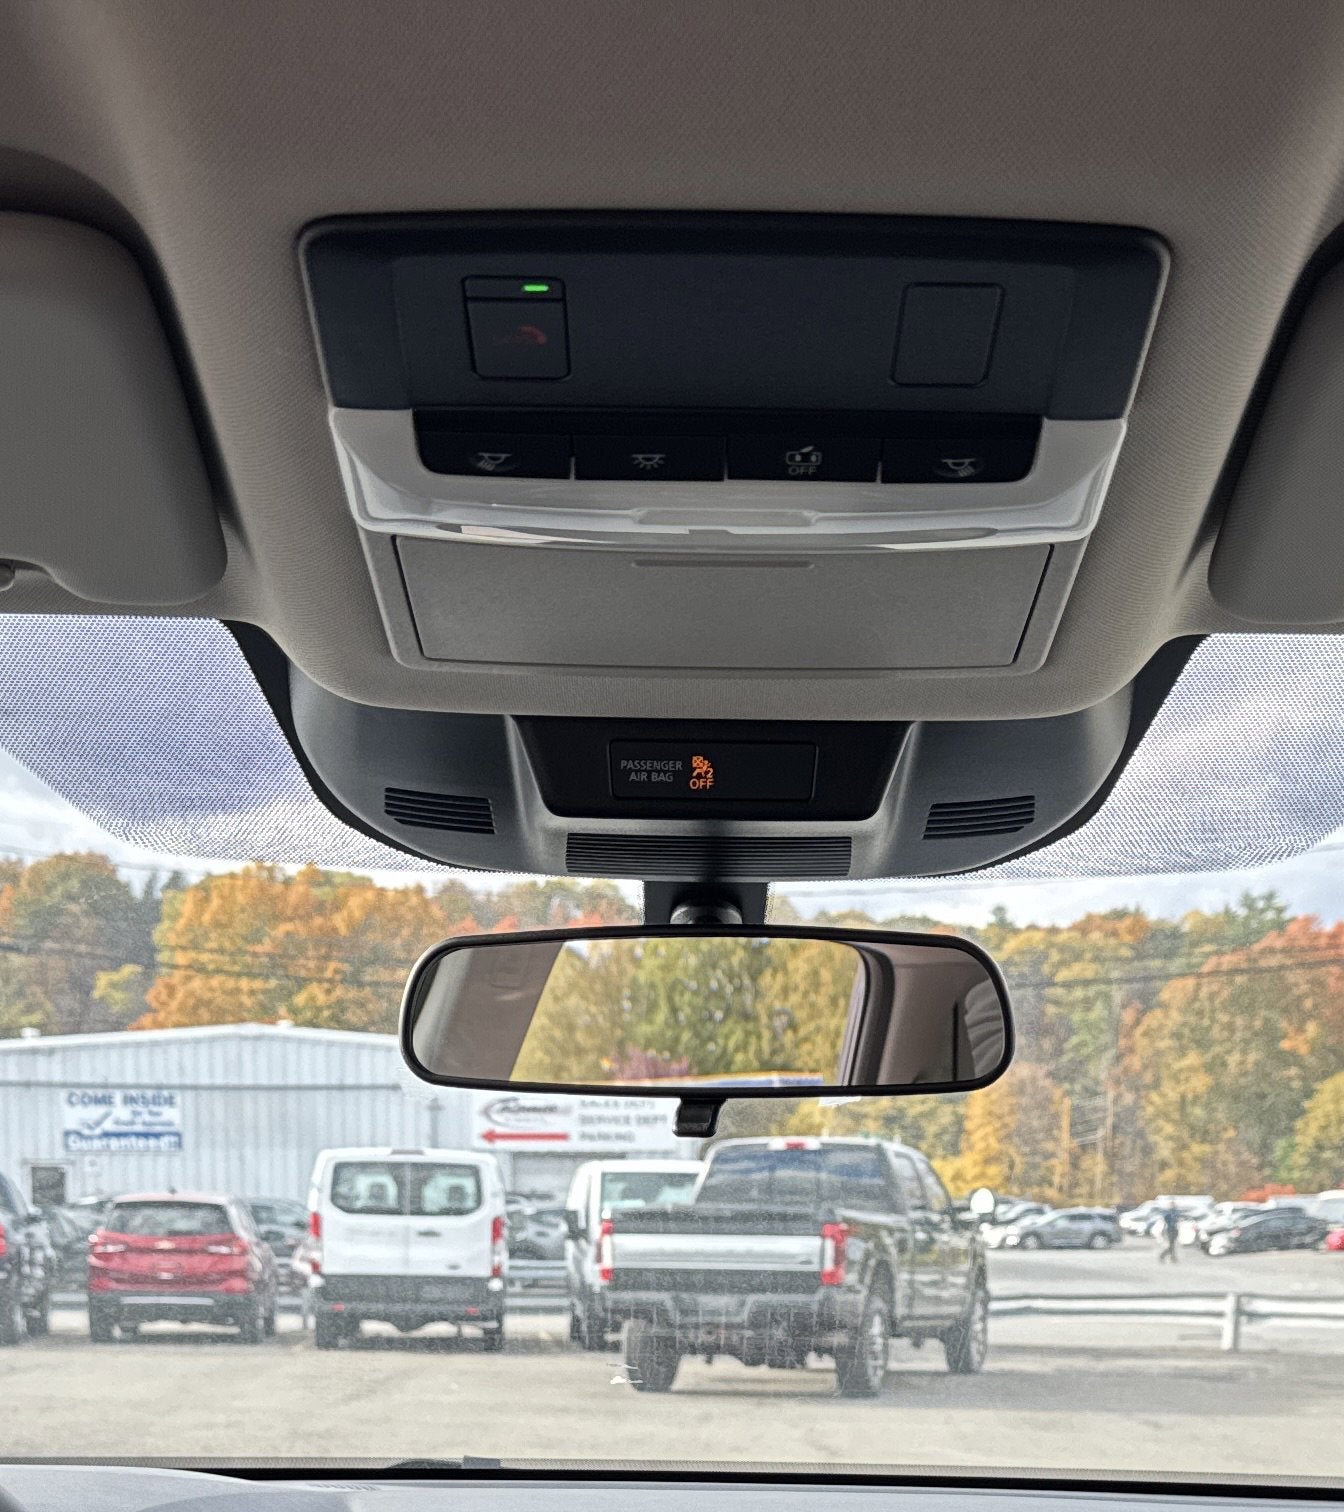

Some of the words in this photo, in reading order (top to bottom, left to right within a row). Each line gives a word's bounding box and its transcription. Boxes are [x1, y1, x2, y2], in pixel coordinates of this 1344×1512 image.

[620, 760, 683, 771] PASSENGER
[629, 772, 648, 781] AIR
[651, 772, 673, 782] BAG
[689, 778, 715, 790] OFF
